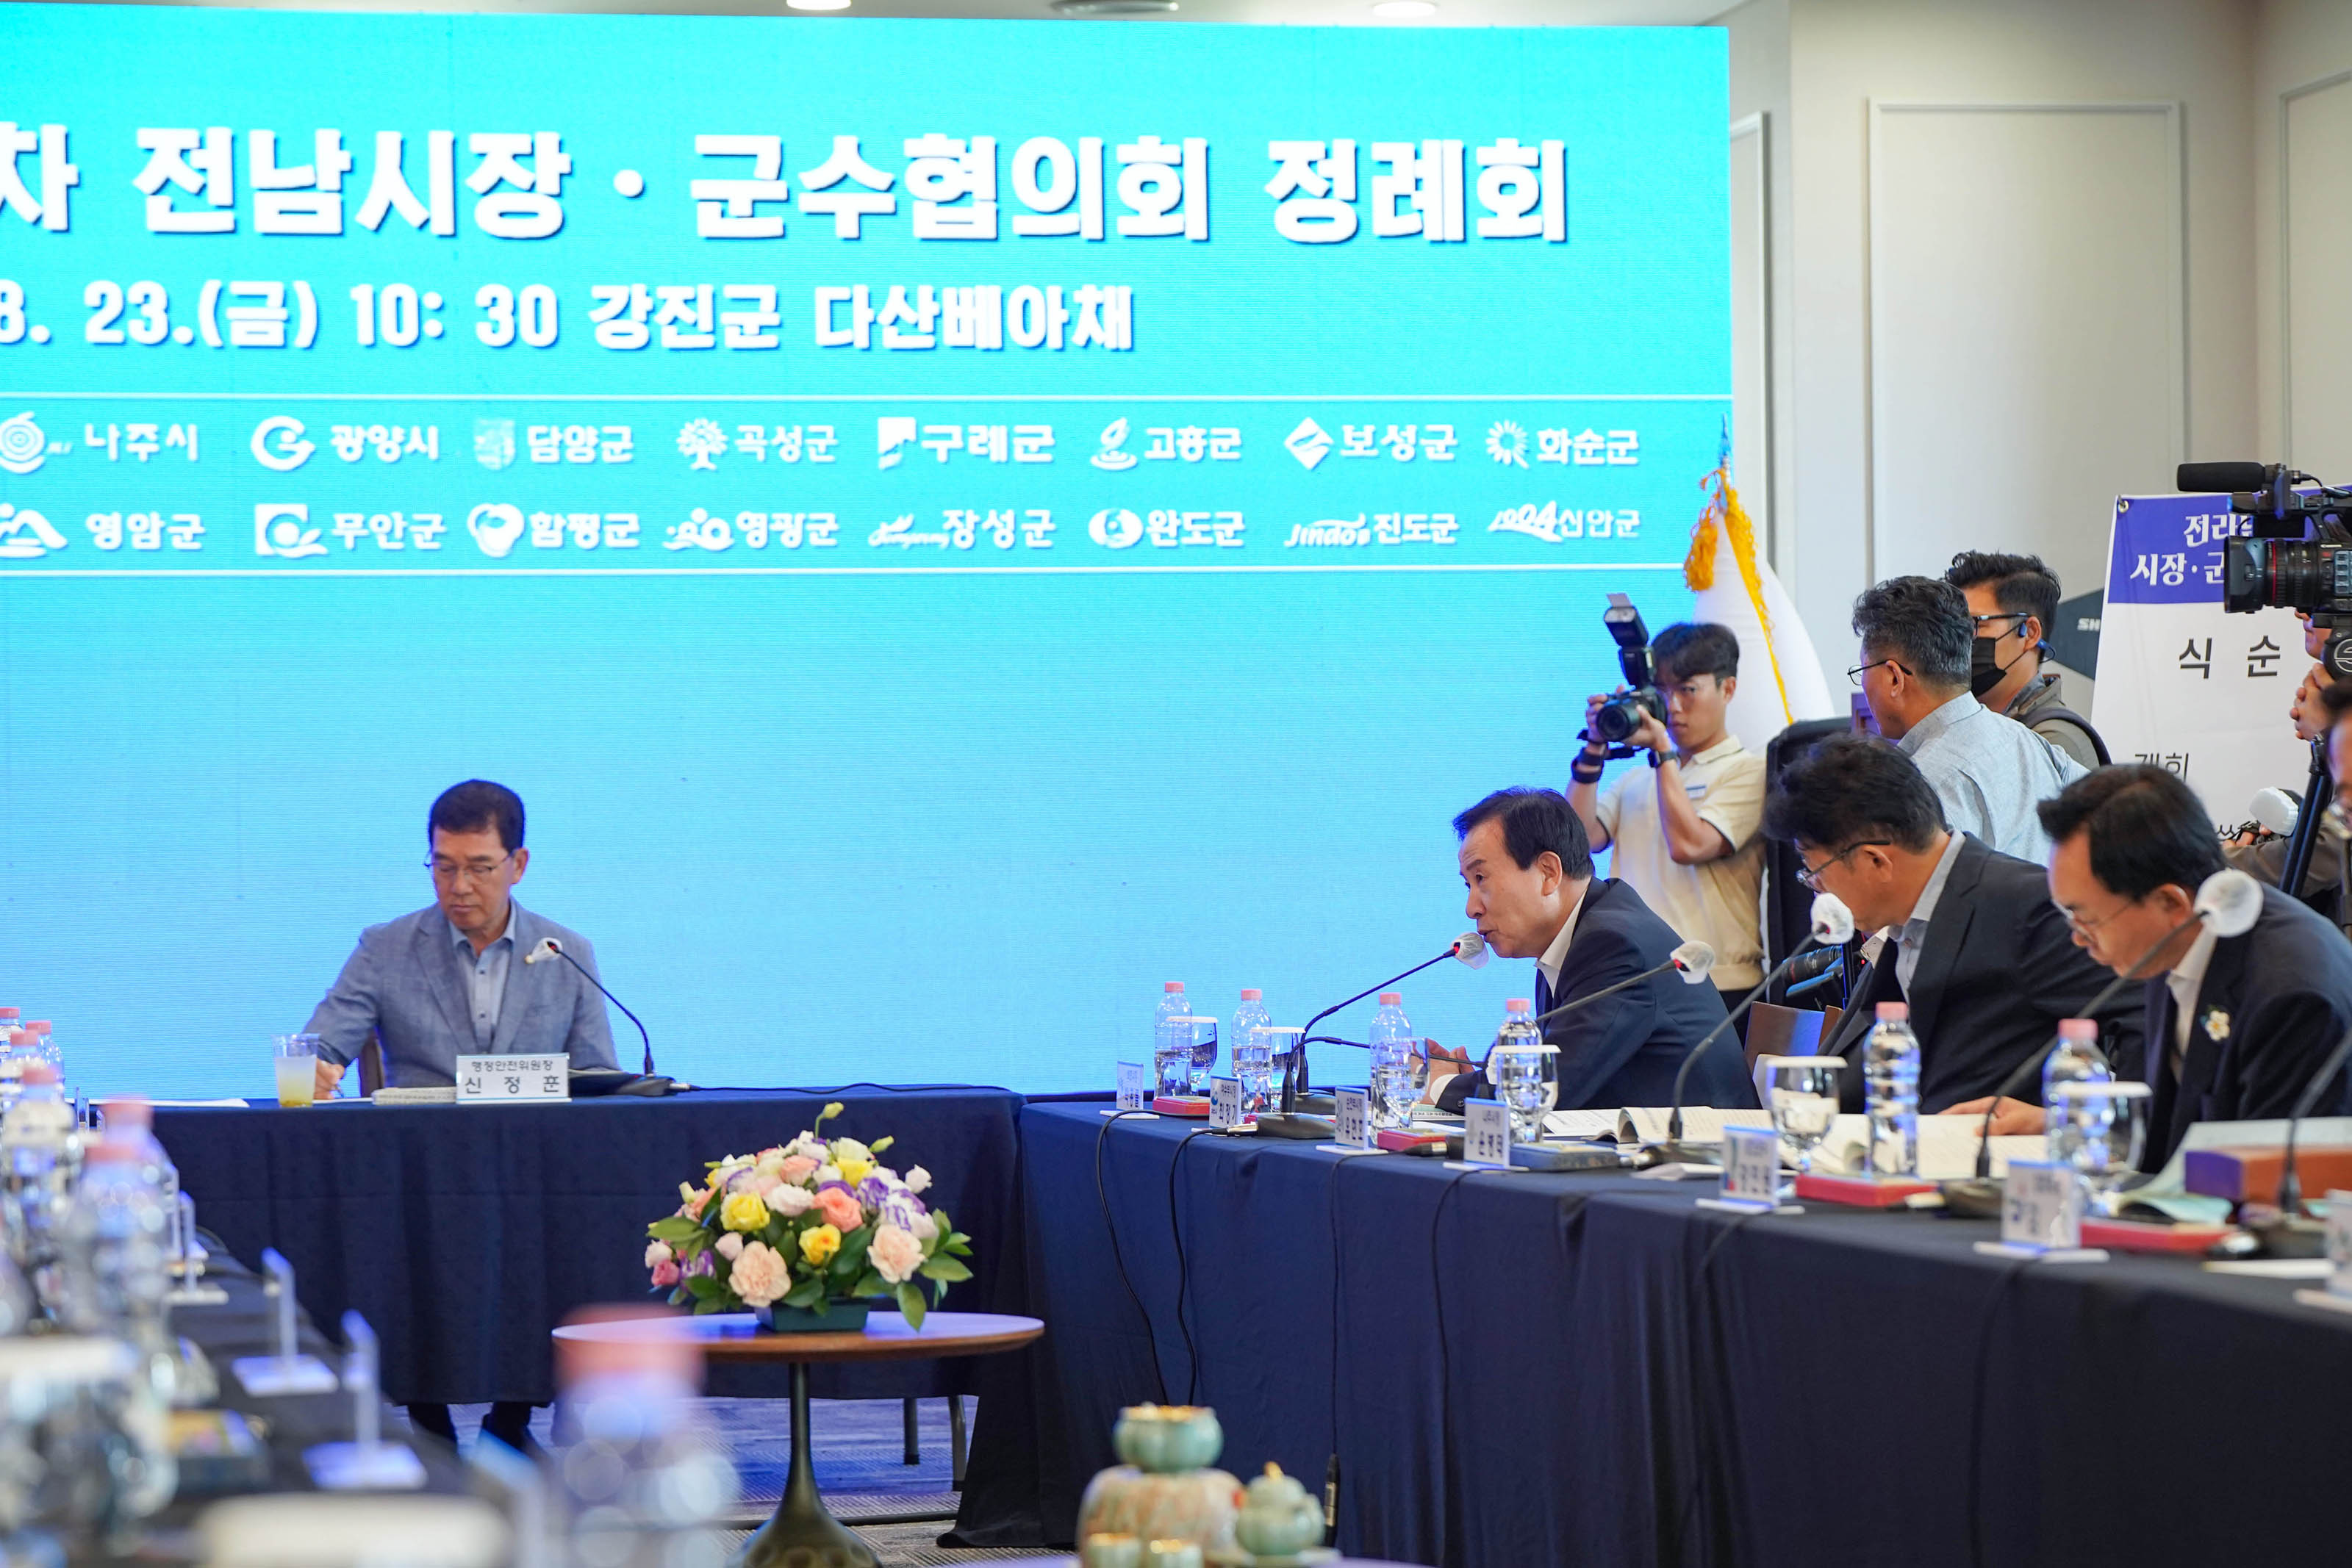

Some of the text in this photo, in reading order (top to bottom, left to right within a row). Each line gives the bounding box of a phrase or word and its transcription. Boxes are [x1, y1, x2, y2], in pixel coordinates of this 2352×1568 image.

[132, 126, 572, 238] 전남시장
[690, 133, 1208, 240] 군수협의회
[1264, 138, 1566, 242] 정례회
[474, 284, 558, 347] 30
[588, 283, 781, 349] 강진군
[814, 284, 1133, 349] 다산베아채
[85, 423, 198, 462] 나주시
[330, 425, 439, 463] 광양시
[527, 425, 634, 463] 담양군
[734, 425, 838, 463] 곡성군
[1144, 425, 1242, 462] 고흥군
[1340, 424, 1458, 461] 보성군
[1536, 428, 1639, 465] 화순군
[85, 511, 206, 550] 영암군
[331, 511, 448, 550] 무안군
[528, 511, 640, 550] 함평군
[735, 511, 839, 549] 영광군
[942, 508, 1056, 550] 장성군
[1145, 509, 1246, 547] 완도군
[1372, 511, 1459, 545] 진도군
[1558, 508, 1641, 542] 신안군
[471, 1060, 553, 1073] 행정안전위원장
